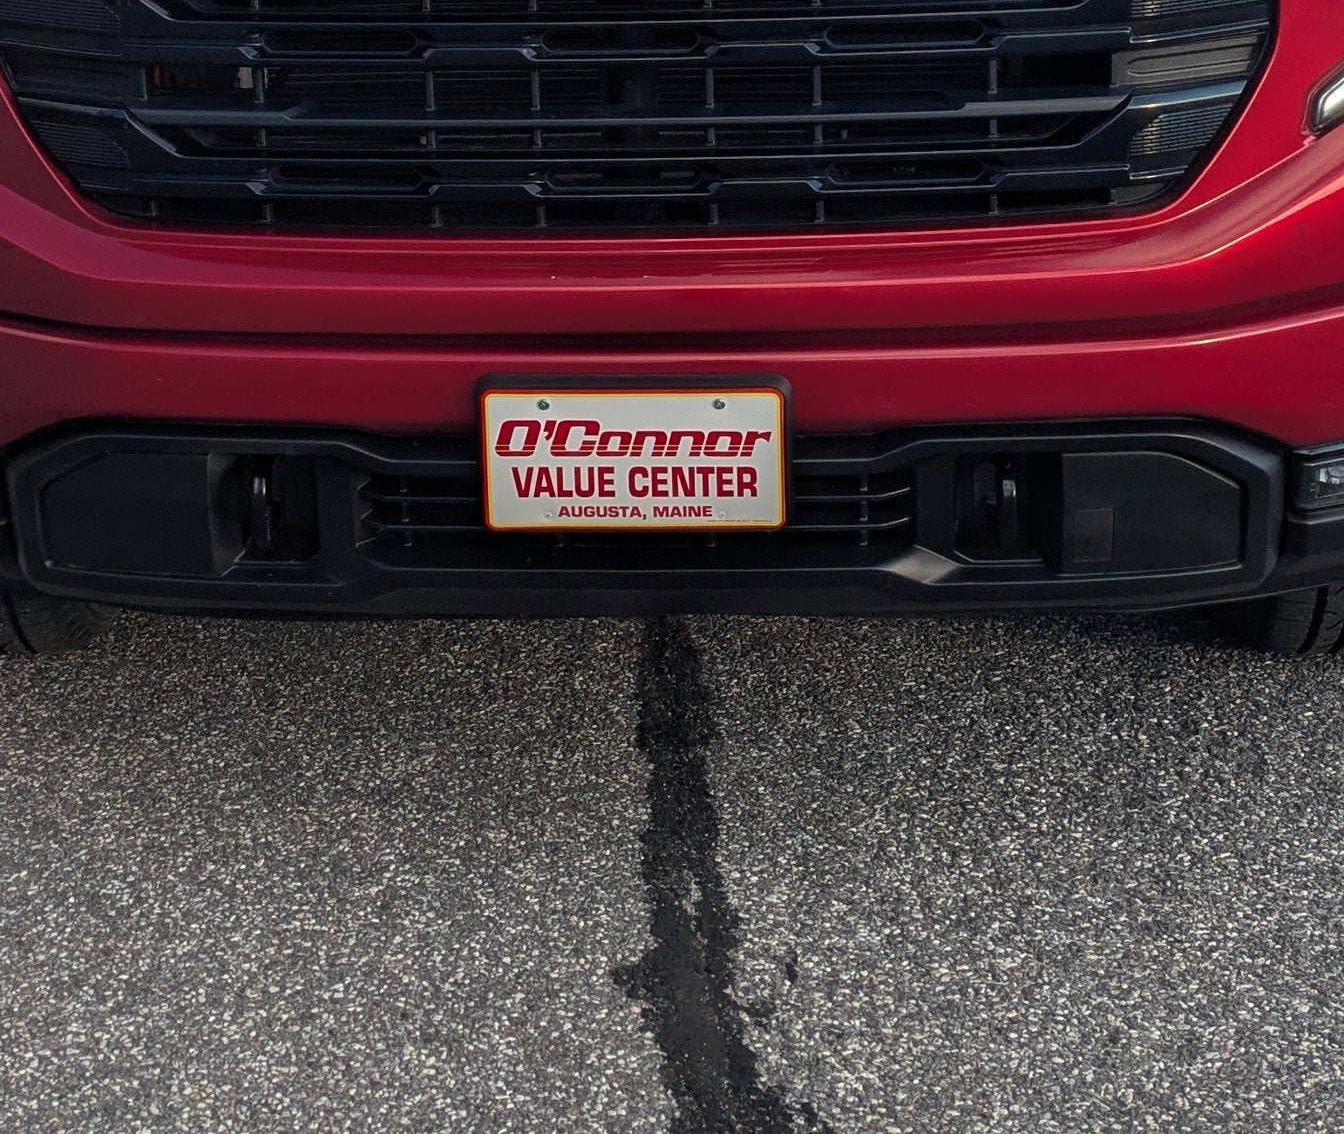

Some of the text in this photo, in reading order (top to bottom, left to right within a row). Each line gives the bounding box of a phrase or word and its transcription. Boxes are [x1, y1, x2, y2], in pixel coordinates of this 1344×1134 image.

[495, 419, 772, 457] O'Connor
[512, 466, 758, 498] VALUE CENTER
[558, 506, 712, 520] AUGUSTA, MAINE
